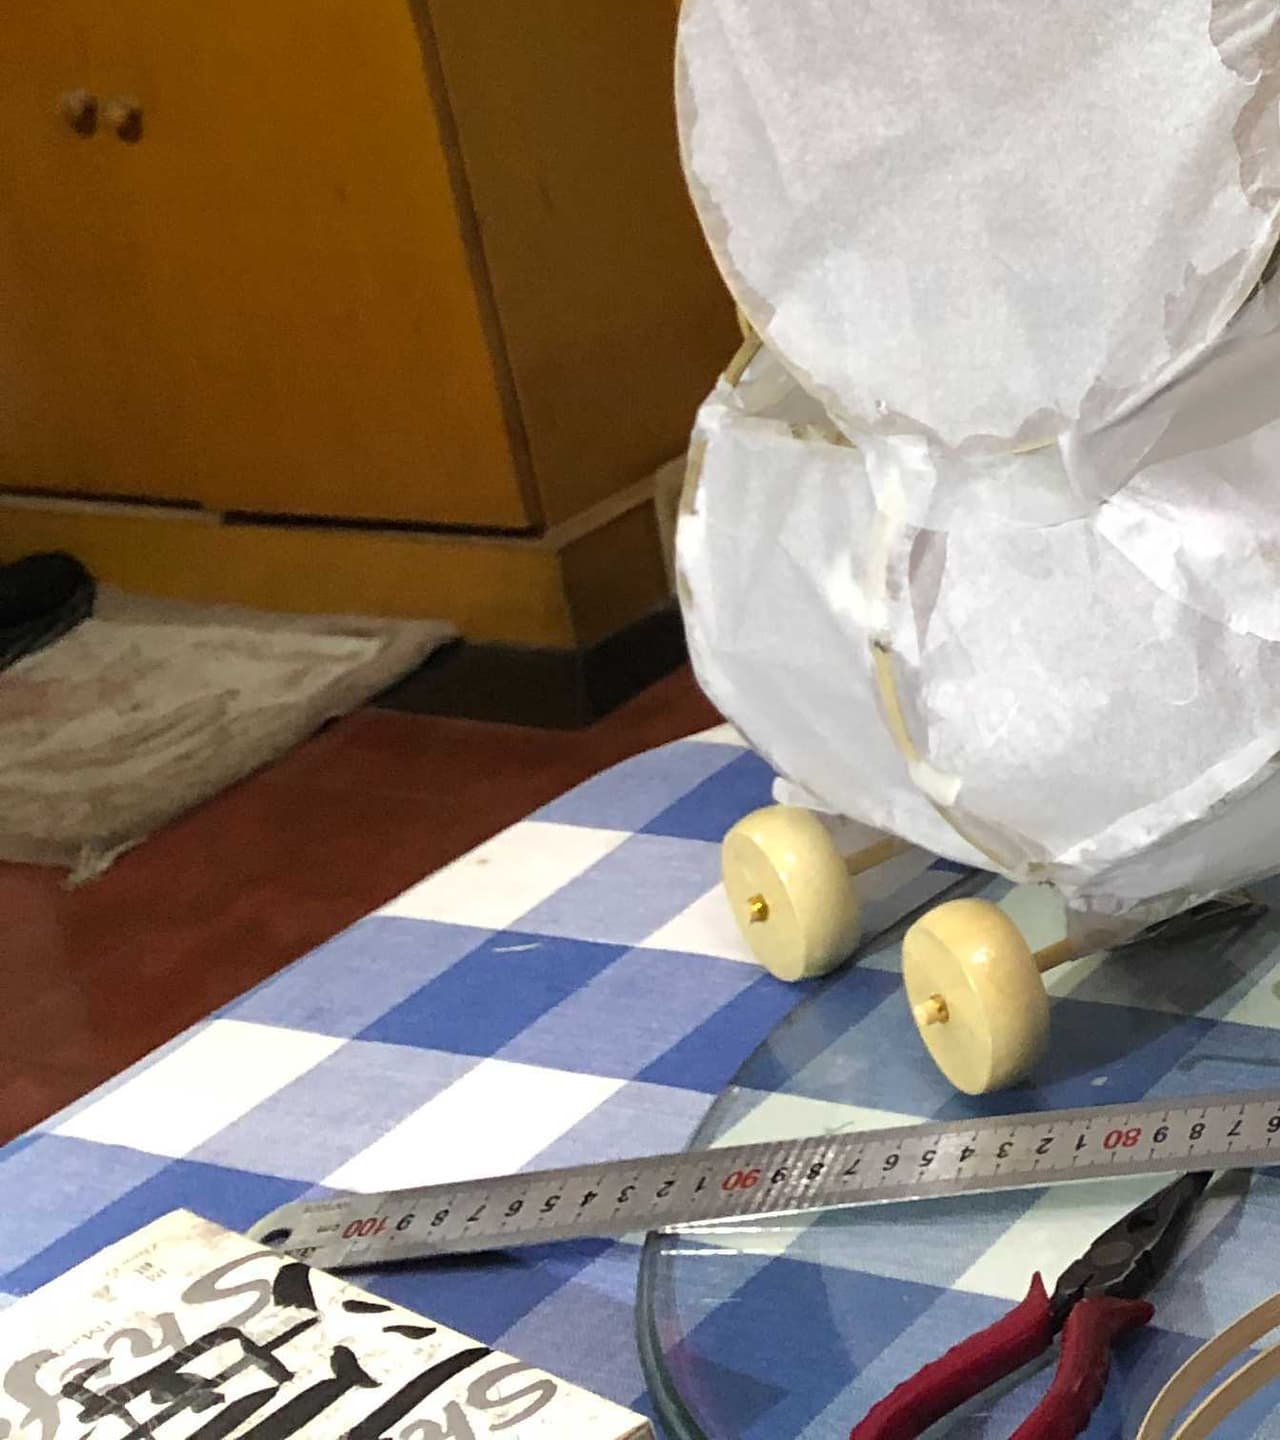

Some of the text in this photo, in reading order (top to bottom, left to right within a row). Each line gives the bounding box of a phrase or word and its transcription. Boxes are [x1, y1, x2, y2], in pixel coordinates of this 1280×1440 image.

[1153, 1125, 1168, 1143] 9
[1188, 1122, 1205, 1140] 8
[1226, 1118, 1243, 1136] 7
[1035, 1137, 1053, 1154] 2
[1076, 1134, 1086, 1151] 1
[1103, 1127, 1142, 1149] 80
[920, 1149, 937, 1167] 5
[959, 1145, 976, 1162] 4
[996, 1141, 1013, 1158] 3
[807, 1162, 825, 1180] 8
[843, 1158, 862, 1175] 7
[882, 1153, 899, 1171] 6
[695, 1175, 706, 1192] 1
[721, 1167, 761, 1191] 90
[771, 1167, 788, 1185] 9
[616, 1184, 635, 1203] 3
[657, 1179, 676, 1197] 2
[540, 1194, 560, 1213] 5
[578, 1189, 599, 1207] 4
[430, 1208, 450, 1227] 8
[465, 1204, 484, 1222] 7
[504, 1199, 524, 1218] 6
[342, 1216, 387, 1240] 100
[396, 1213, 415, 1232] 9
